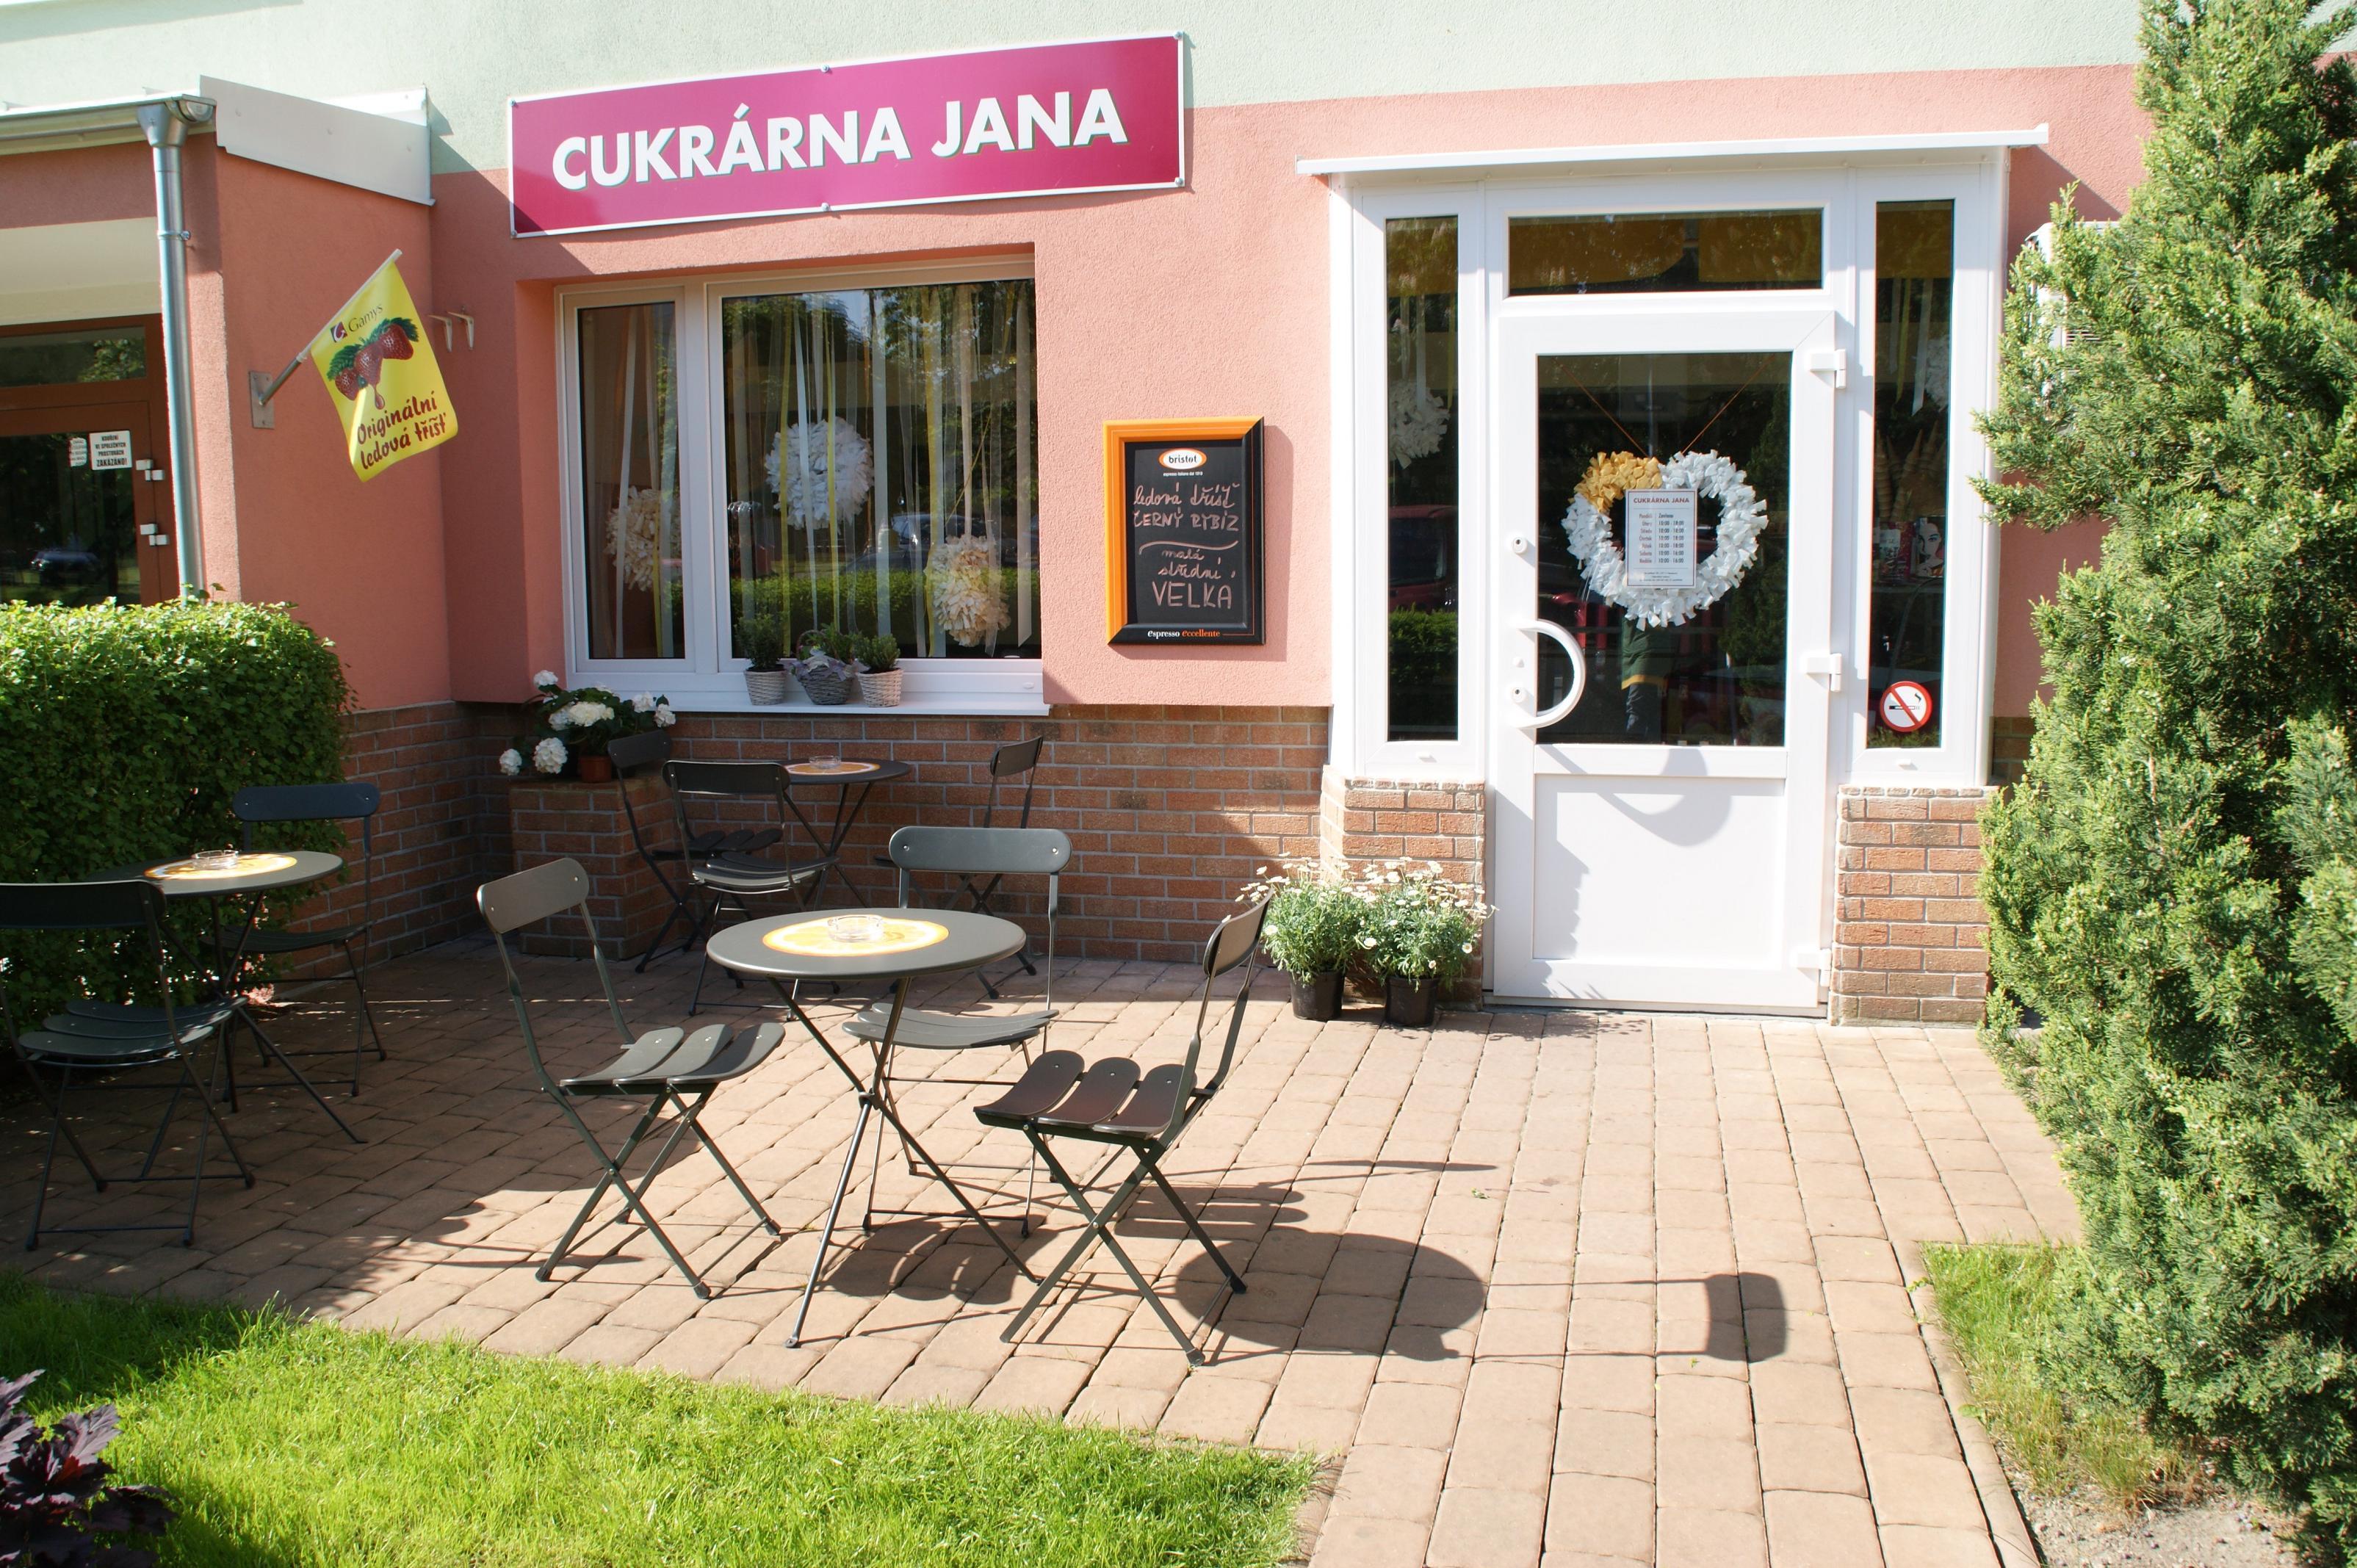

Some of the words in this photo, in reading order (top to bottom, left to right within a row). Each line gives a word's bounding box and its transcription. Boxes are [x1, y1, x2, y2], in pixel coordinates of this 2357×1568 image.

[552, 102, 913, 189] CUKRÁRNA
[931, 88, 1128, 158] JANA
[358, 390, 437, 444] Originální
[361, 427, 411, 469] ledová
[1169, 455, 1196, 463] bristot
[1133, 482, 1183, 507] ledová
[1133, 507, 1183, 528] ČERNÝ
[1162, 549, 1205, 560] malá
[1147, 630, 1180, 640] espresso
[1182, 629, 1220, 637] eccellente
